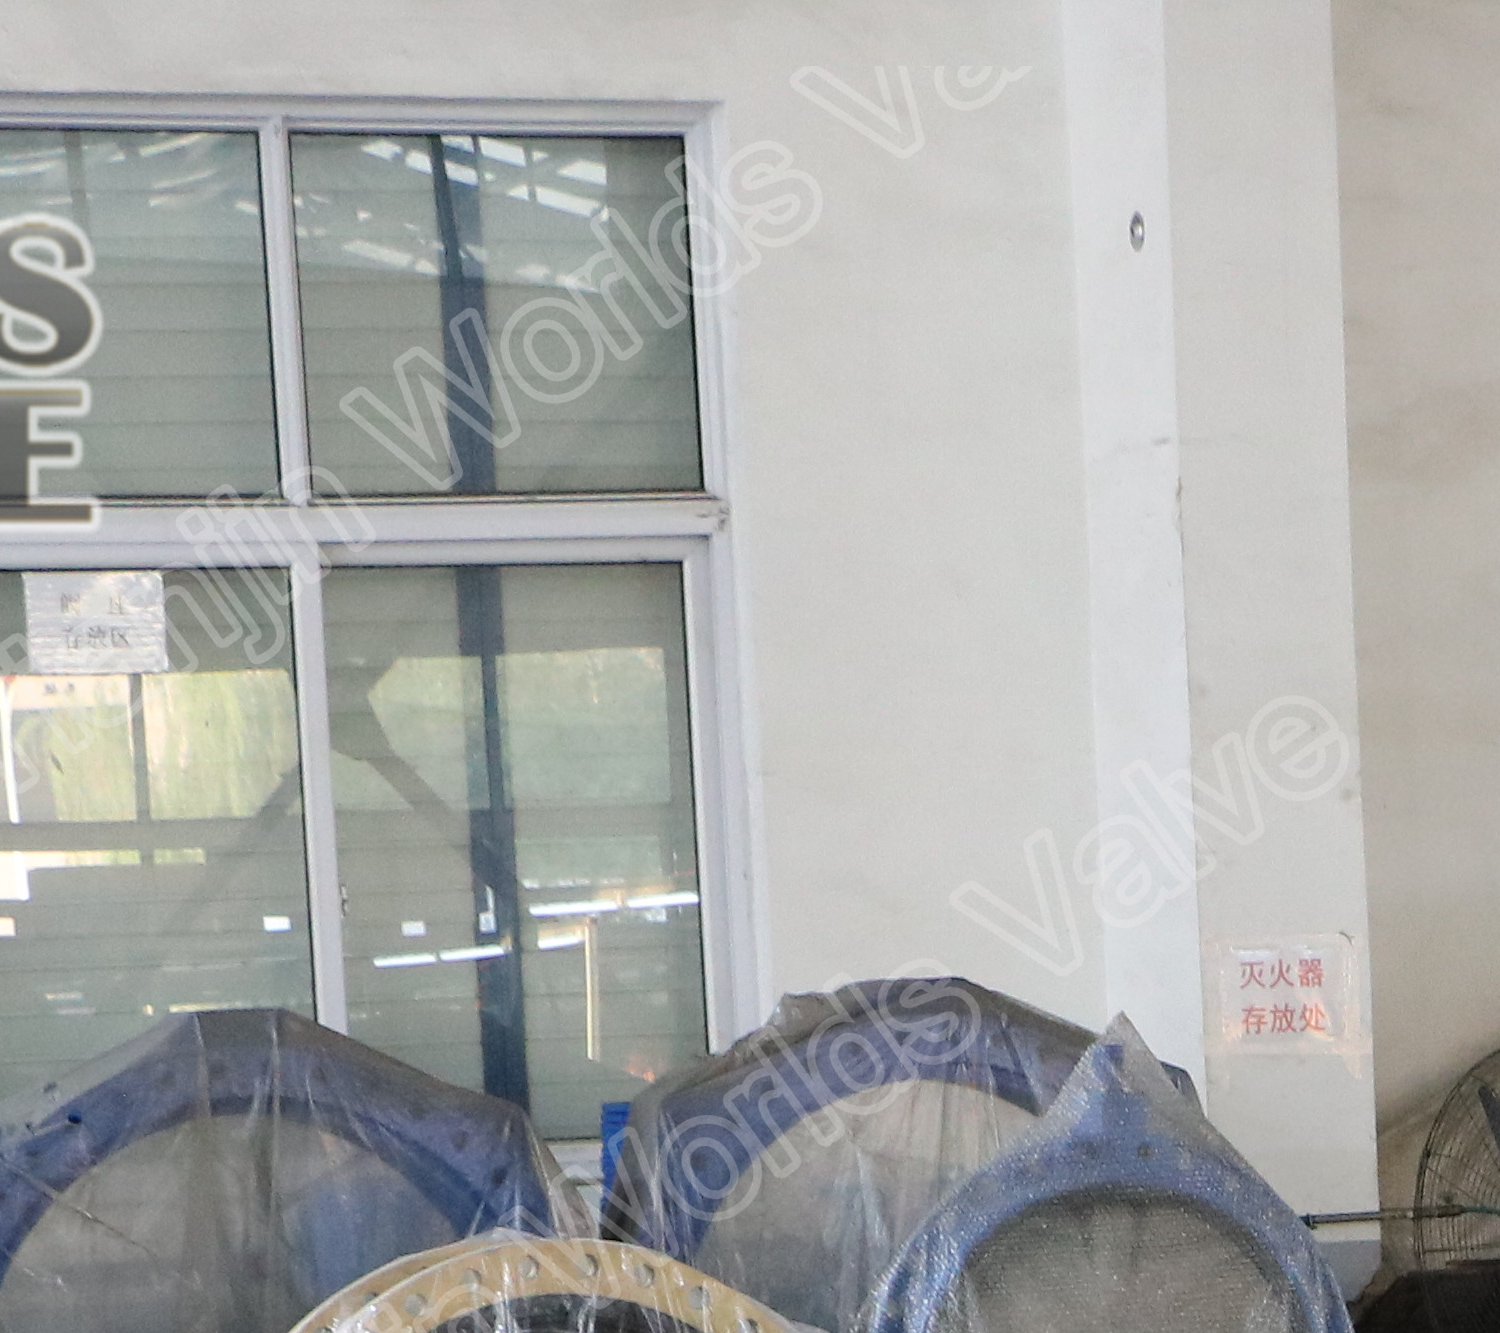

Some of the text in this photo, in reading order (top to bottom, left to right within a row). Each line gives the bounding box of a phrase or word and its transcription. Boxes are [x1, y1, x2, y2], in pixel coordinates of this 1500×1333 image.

[1240, 958, 1324, 989] 灭火器
[1241, 1003, 1326, 1035] 存放处
